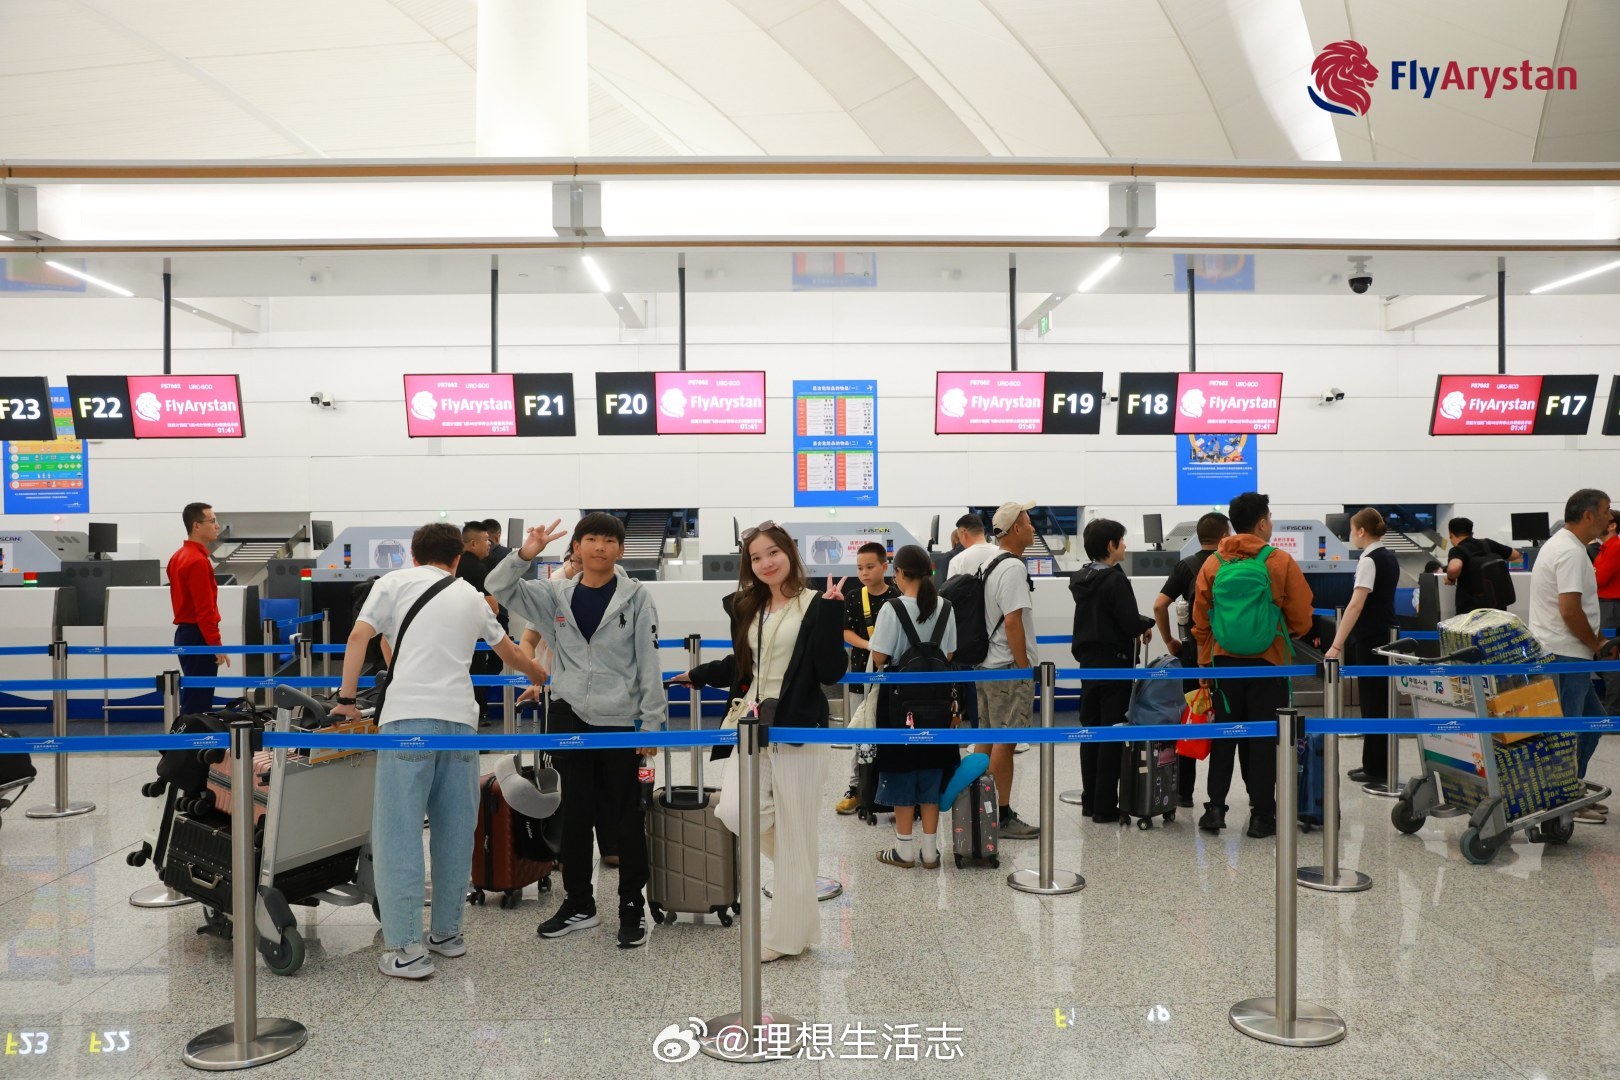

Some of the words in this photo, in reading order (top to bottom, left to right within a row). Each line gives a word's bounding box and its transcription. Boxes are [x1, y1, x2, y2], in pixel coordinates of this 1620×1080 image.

[0, 398, 41, 420] F23
[79, 397, 123, 419] F22
[165, 399, 237, 415] FlyArystan
[441, 398, 512, 414] FlyArystan
[523, 395, 564, 416] F21
[605, 393, 648, 415] F20
[690, 395, 762, 411] FlyArystan
[971, 395, 1041, 411] FlyArystan
[1053, 393, 1094, 415] F19
[1127, 393, 1169, 415] F18
[1209, 396, 1276, 411] FlyArystan
[1469, 398, 1535, 413] FlyArystan
[1545, 395, 1587, 416] F17
